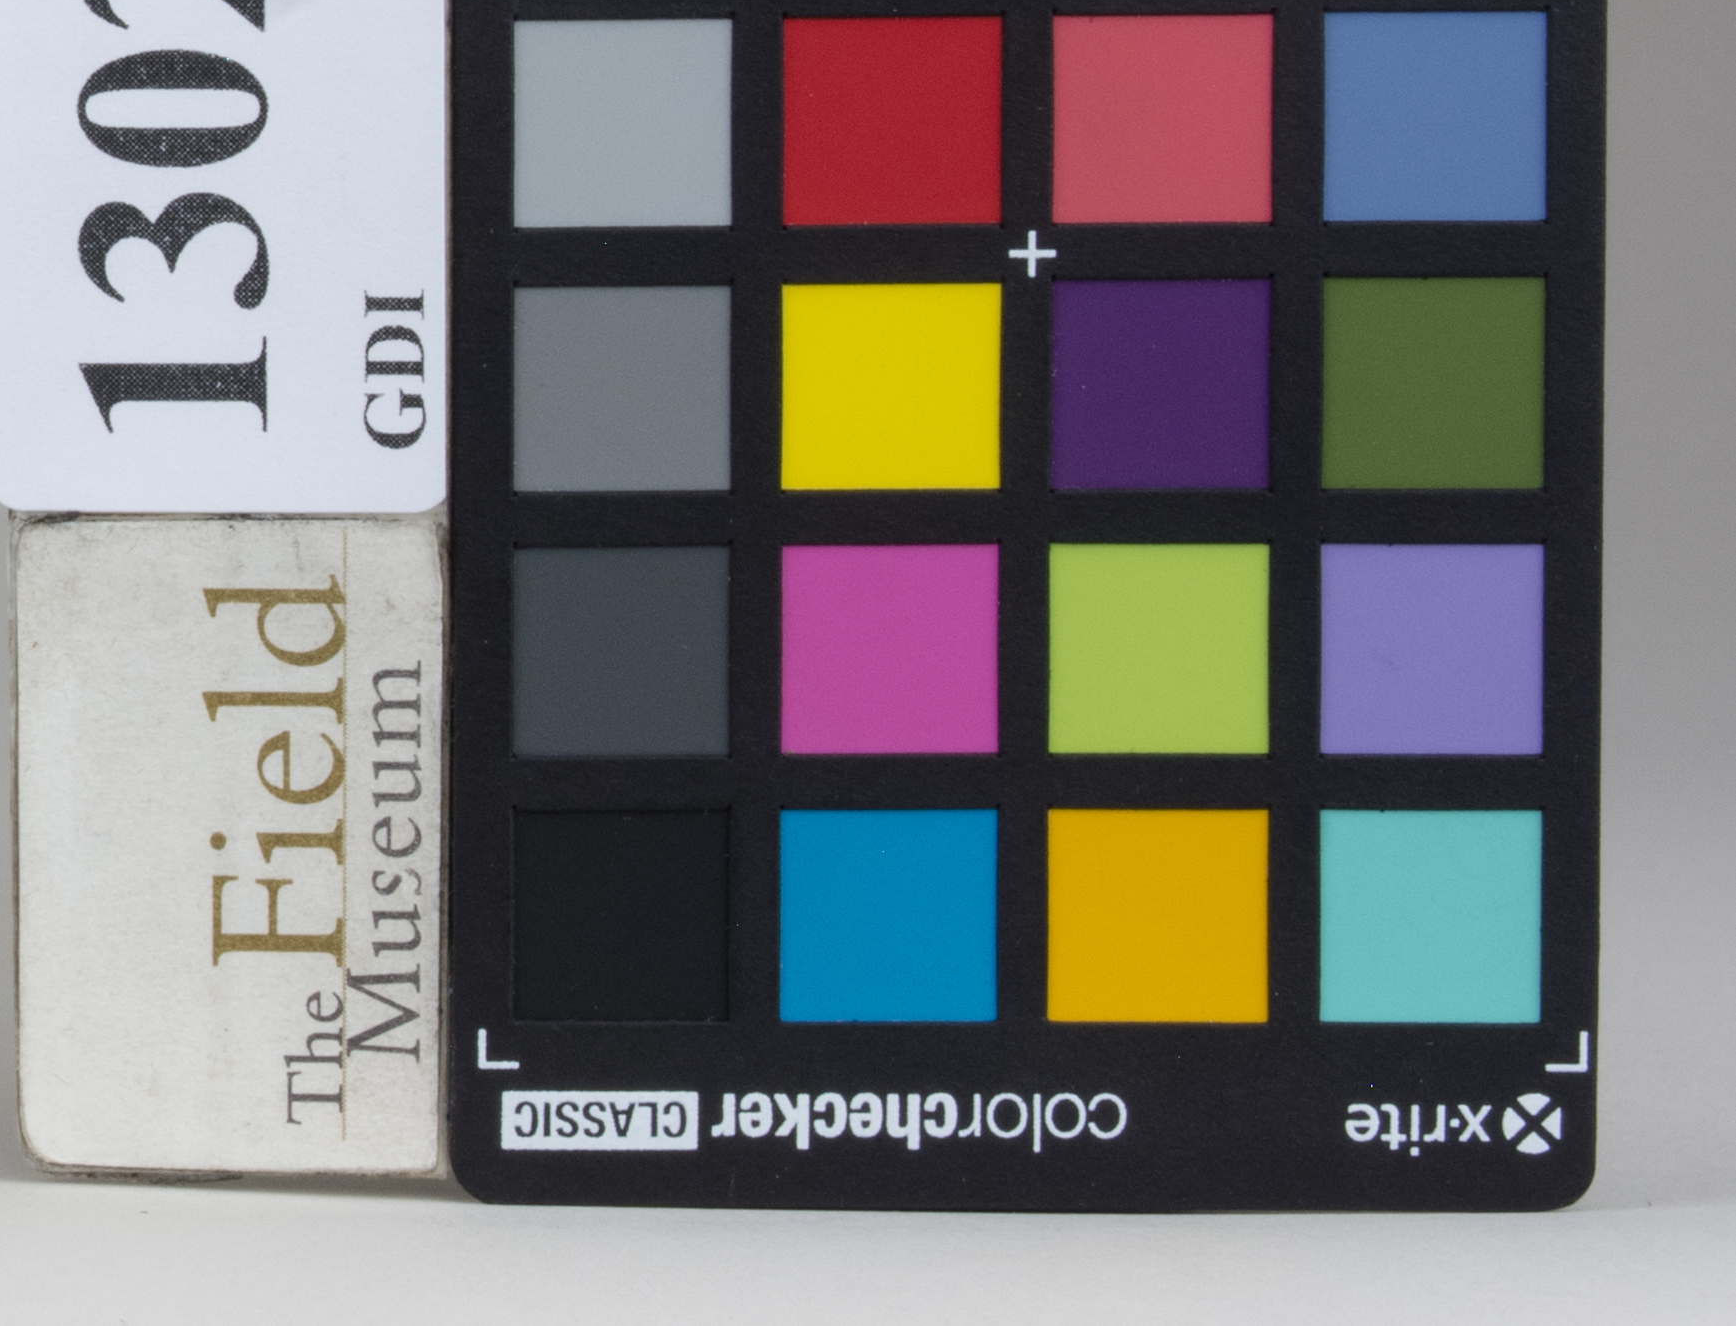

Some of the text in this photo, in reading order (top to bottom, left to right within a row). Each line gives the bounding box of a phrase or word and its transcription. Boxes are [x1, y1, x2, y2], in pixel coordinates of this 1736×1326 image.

[362, 294, 426, 451] GDI
[202, 574, 347, 1125] The Field
[346, 659, 423, 1062] Museum
[513, 1090, 1129, 1154] colorchecker CLASSIC
